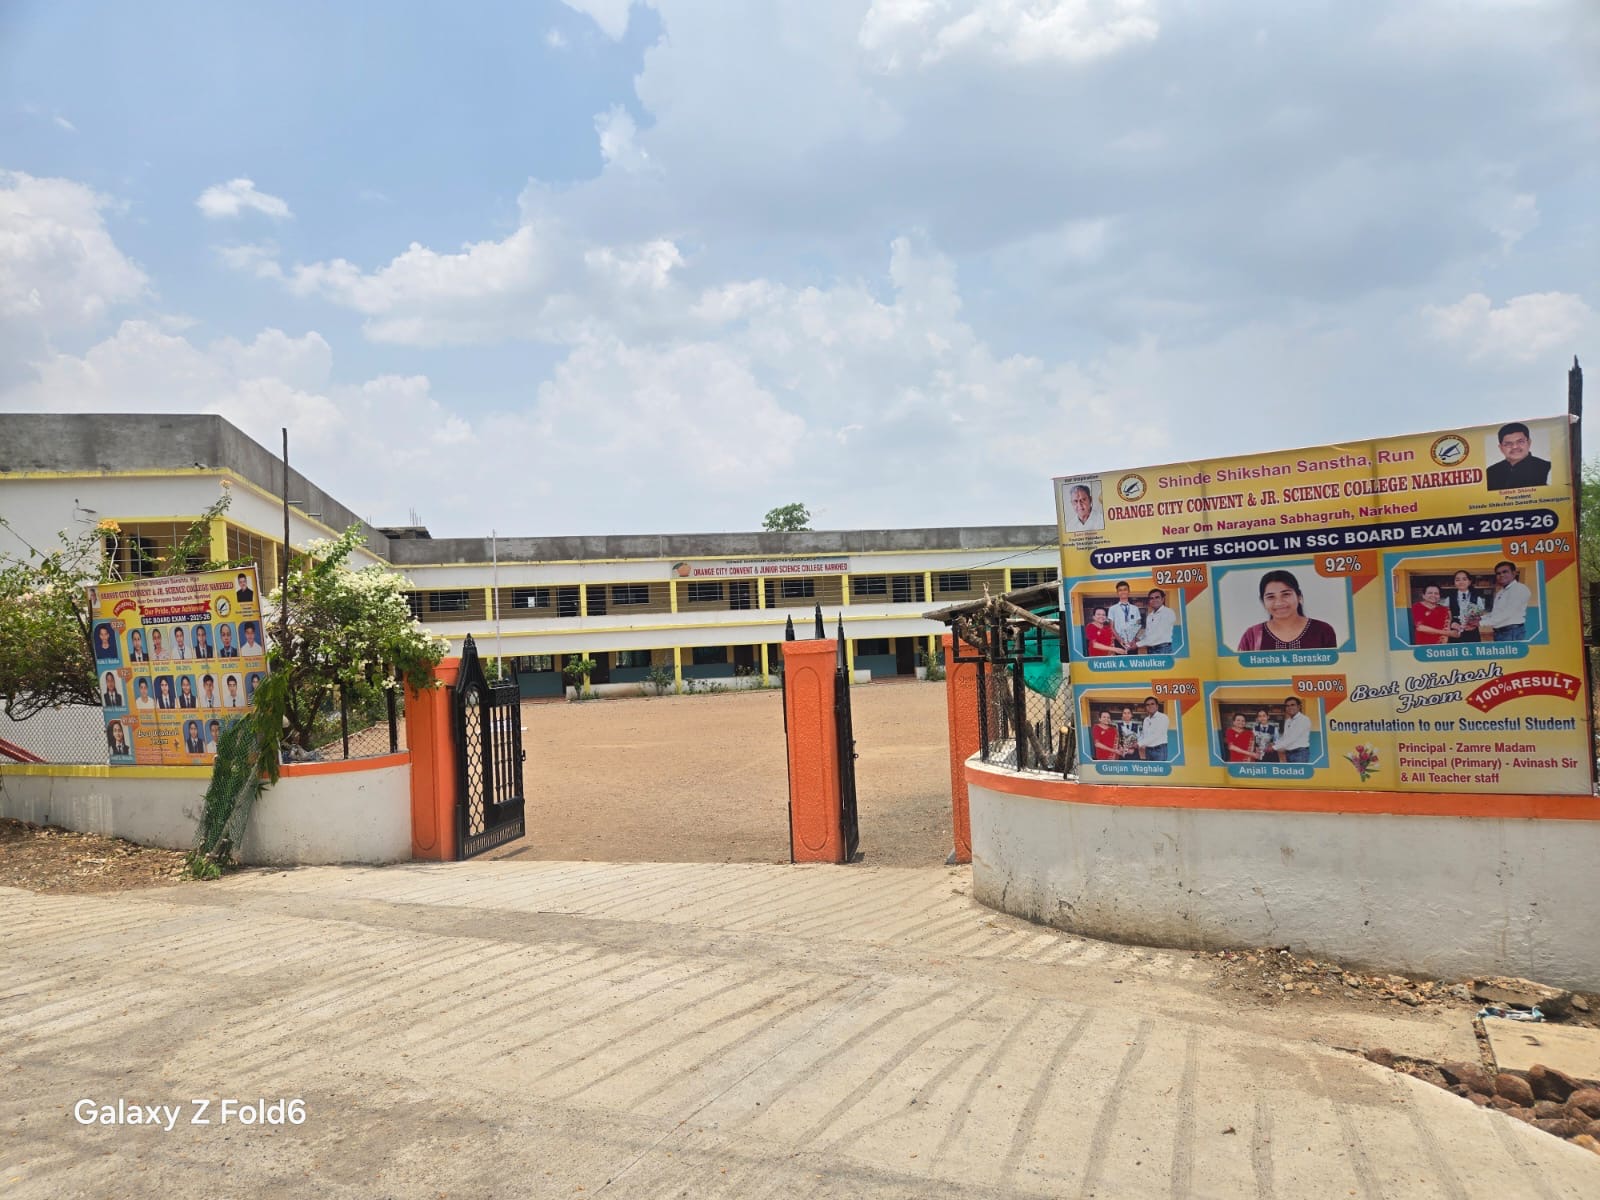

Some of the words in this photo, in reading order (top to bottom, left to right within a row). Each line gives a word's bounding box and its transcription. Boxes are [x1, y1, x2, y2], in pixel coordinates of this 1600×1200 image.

[1158, 472, 1211, 489] Shinde
[1216, 463, 1291, 482] Shikshan
[1296, 455, 1372, 472] Sanstha,
[1377, 450, 1415, 465] Run
[1107, 503, 1154, 521] ORANGE
[1157, 499, 1183, 517] CITY
[1186, 493, 1243, 514] CONVENT
[1247, 492, 1257, 507] &
[1261, 490, 1280, 505] JR.
[1283, 482, 1340, 503] SCIENCE
[1343, 475, 1408, 498] COLLEGE
[1411, 468, 1483, 490] NARKHED
[1161, 524, 1191, 536] Near
[1193, 521, 1213, 533] Om
[1216, 516, 1276, 531] Narayana
[1280, 509, 1354, 525] Sabhagruh,
[1359, 502, 1418, 518] Narkhed
[1094, 548, 1151, 565] TOPPER
[1155, 546, 1175, 559] OF
[1178, 543, 1209, 557] THE
[1213, 539, 1279, 555] SCHOOL
[1284, 536, 1302, 549] IN
[1306, 533, 1339, 547] SSC
[1344, 528, 1404, 544] BOARD
[1410, 523, 1463, 539] EXAM
[1480, 514, 1554, 533] 2025-26
[1509, 538, 1570, 556] 91.40%
[693, 567, 714, 576] ORANGE
[715, 566, 728, 576] CITY
[729, 565, 753, 575] CONVENT
[754, 566, 759, 574] &
[760, 565, 778, 574] JUNIOR
[779, 564, 801, 573] SCIENCE
[801, 563, 823, 572] COLLEGE
[824, 562, 848, 571] NARKHED
[1325, 555, 1361, 573] 92%
[1155, 567, 1204, 585] 92.20%
[154, 616, 171, 624] BOARD
[171, 615, 187, 623] EXAM
[1249, 655, 1280, 664] Harsha
[1292, 653, 1331, 663] Baraskar
[1426, 647, 1459, 658] Sonali
[1461, 646, 1473, 657] G.
[1475, 645, 1518, 656] Mahalle
[1119, 660, 1128, 668] A.
[1155, 683, 1197, 695] 91.20%
[1297, 679, 1344, 693] 90.00%
[1350, 681, 1400, 702] Best
[1405, 663, 1504, 691] Wishesh
[1397, 689, 1462, 713] From
[1329, 718, 1415, 734] Congratulation
[1418, 721, 1430, 732] to
[1434, 722, 1454, 732] our
[1458, 718, 1521, 732] Succesful
[1524, 717, 1576, 731] Student
[1398, 742, 1446, 755] Principal
[1456, 743, 1492, 754] Zamre
[1494, 742, 1536, 753] Madam
[1239, 766, 1267, 776] Anjali
[1272, 766, 1305, 775] Bodad
[1399, 757, 1448, 771] Principal
[1451, 757, 1503, 770] (Primary)
[1512, 757, 1558, 769] Avinash
[1561, 757, 1579, 769] Sir
[1400, 773, 1408, 783] &
[1411, 773, 1426, 783] All
[1428, 772, 1472, 783] Teacher
[1474, 772, 1500, 784] staff
